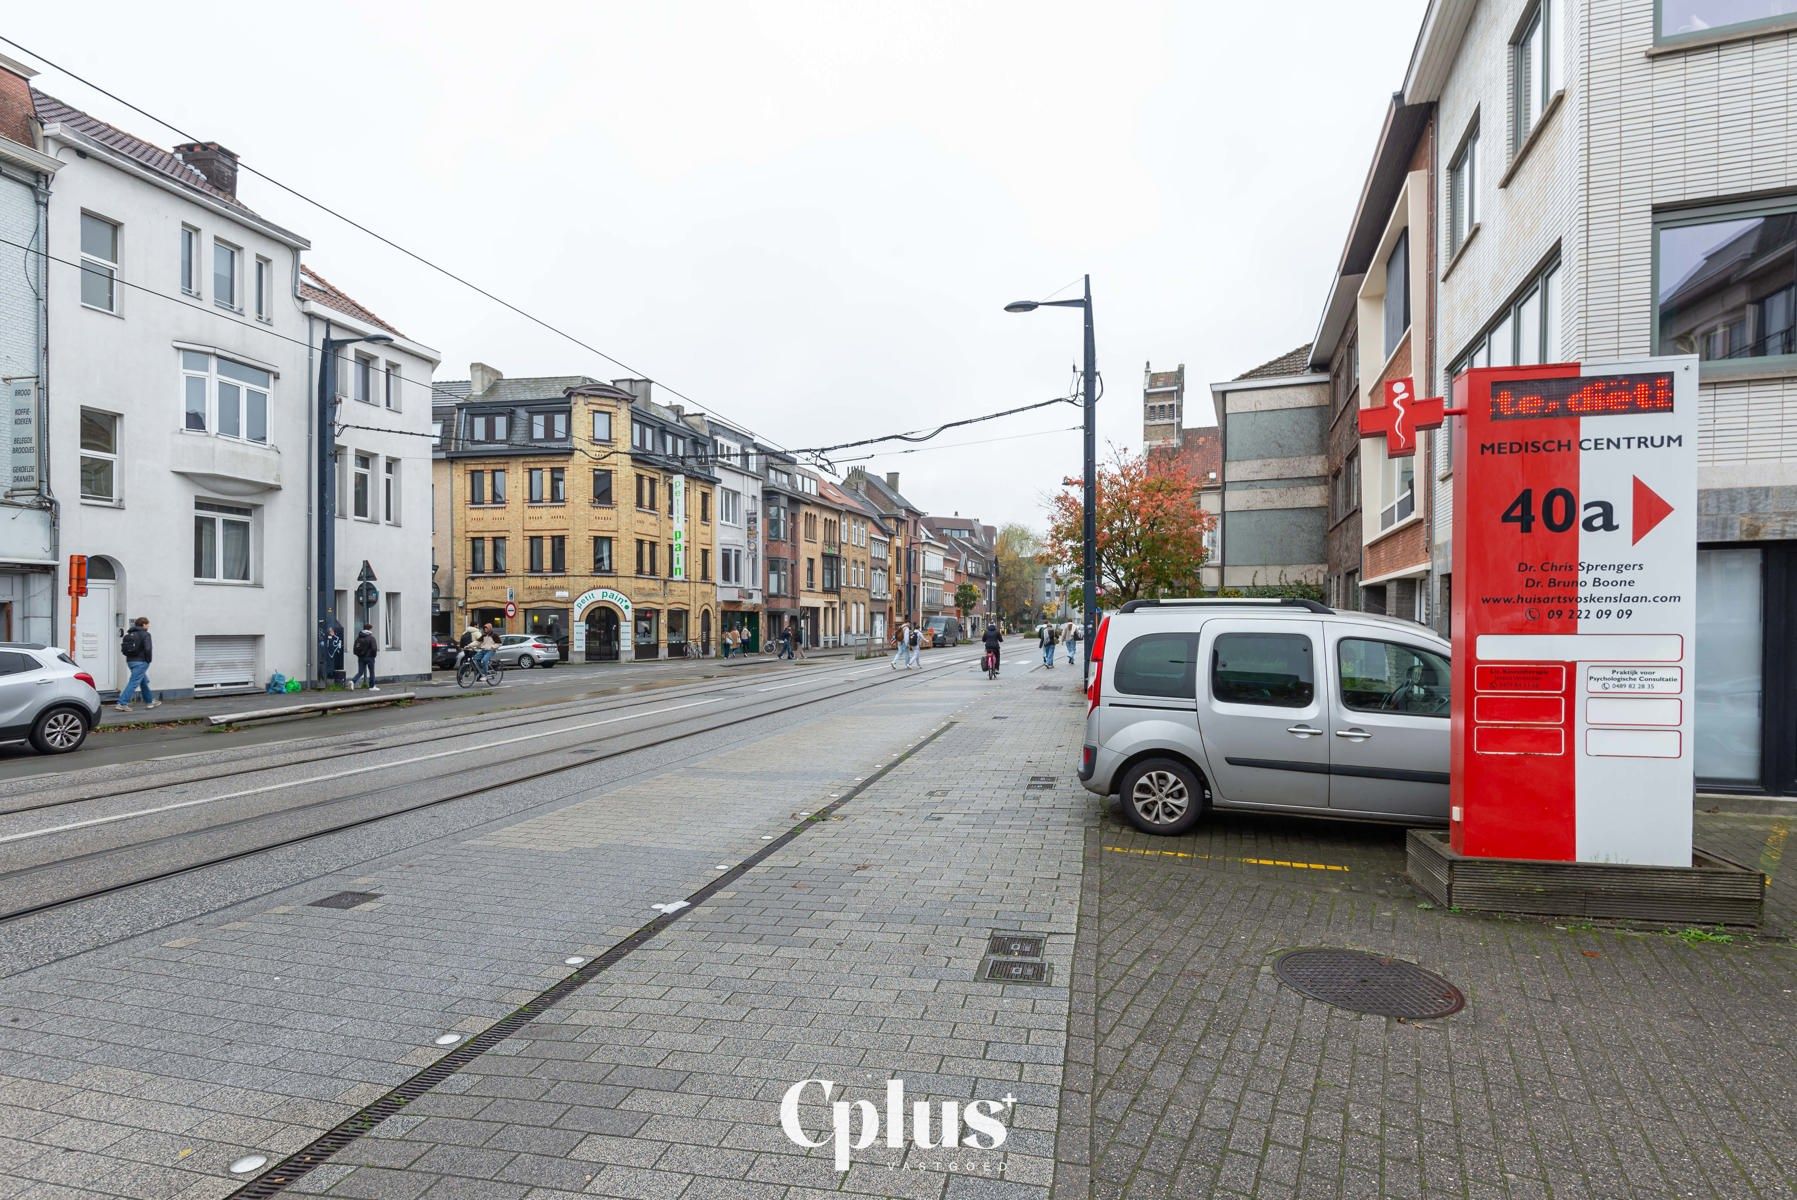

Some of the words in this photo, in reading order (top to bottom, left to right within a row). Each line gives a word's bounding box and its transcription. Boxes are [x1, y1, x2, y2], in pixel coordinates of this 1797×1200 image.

[14, 389, 32, 397] BROOD
[13, 436, 33, 445] BELEGDE
[1480, 439, 1572, 456] MEDISCH
[1579, 434, 1683, 451] CENTRUM
[12, 446, 35, 454] BROODJES
[12, 465, 35, 474] GEKOELDE
[13, 475, 35, 483] DRANKEN
[1501, 487, 1620, 534] 40a
[674, 530, 682, 577] pain
[1517, 562, 1537, 573] Dr.
[1540, 561, 1574, 573] Chris
[1578, 561, 1644, 574] Sprengers
[1524, 578, 1544, 588] Dr.
[1547, 577, 1588, 588] Bruno
[1592, 577, 1636, 588] Boone
[576, 592, 596, 610] petit
[601, 591, 624, 606] pain
[1481, 593, 1681, 605] www.huisartsvoskenslaan.com
[1547, 609, 1563, 619] 09
[1567, 609, 1591, 619] 222
[1595, 609, 1613, 619] 09
[1616, 608, 1633, 619] 09
